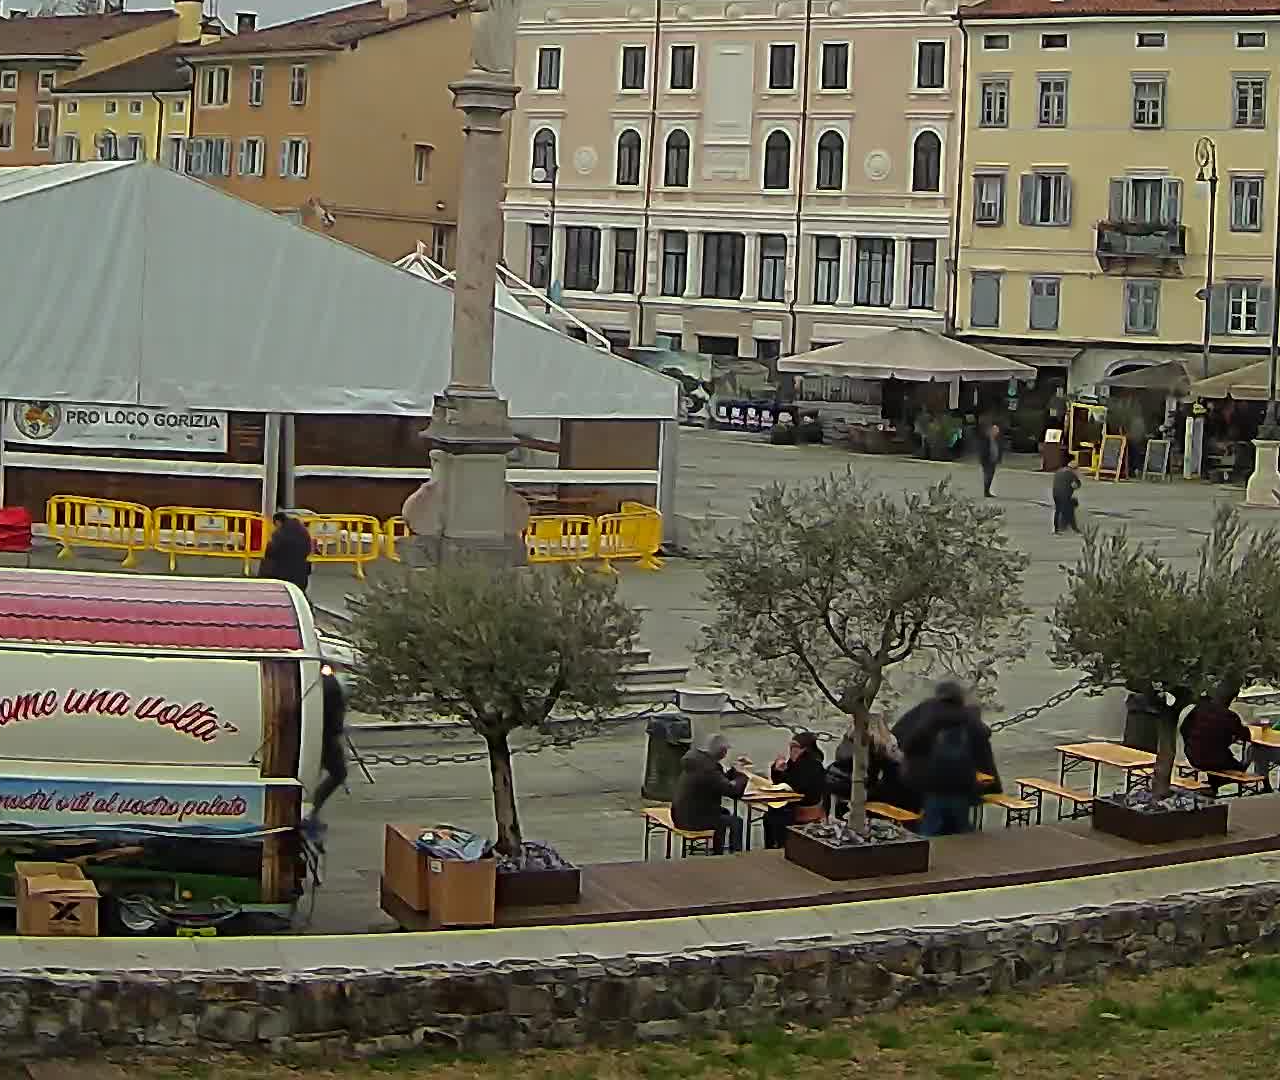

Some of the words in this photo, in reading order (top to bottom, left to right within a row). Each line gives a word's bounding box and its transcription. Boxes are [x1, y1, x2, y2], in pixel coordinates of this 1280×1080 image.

[66, 410, 100, 424] PRO
[104, 410, 149, 426] LOCO
[153, 413, 220, 428] GORIZIA
[63, 687, 131, 716] una
[55, 790, 95, 812] orti
[92, 792, 120, 813] al
[118, 795, 179, 816] vostro
[177, 794, 247, 823] palato
